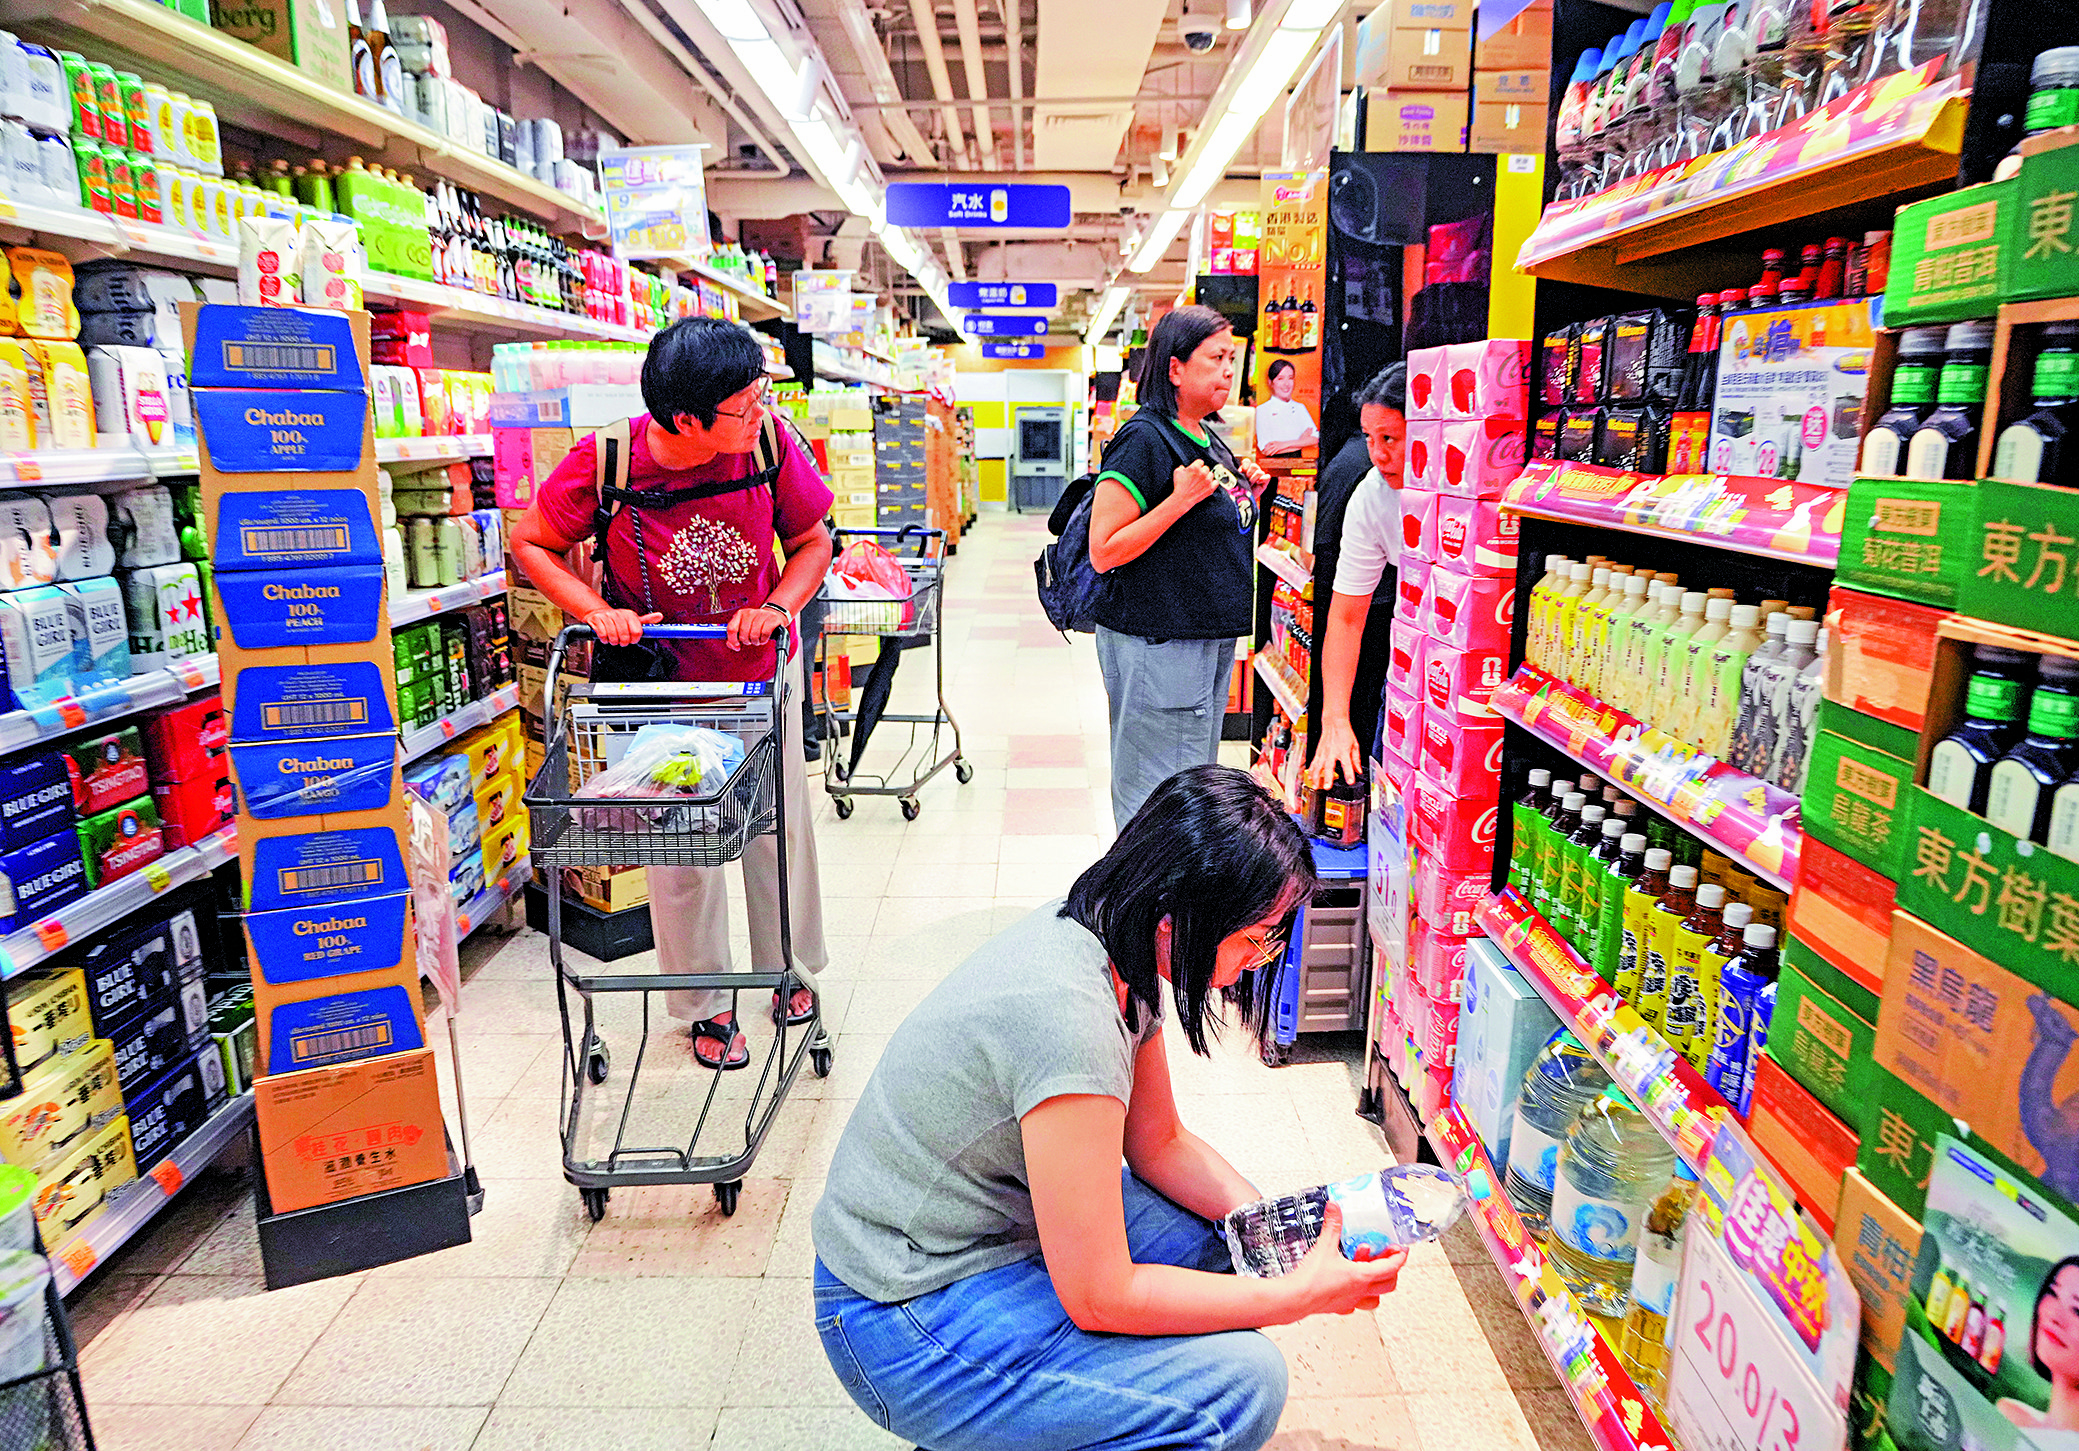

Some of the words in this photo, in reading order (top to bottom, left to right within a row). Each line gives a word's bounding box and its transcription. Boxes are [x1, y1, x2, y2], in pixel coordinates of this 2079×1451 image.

[952, 193, 984, 210] 汽水
[1266, 226, 1322, 264] No.1
[244, 407, 326, 426] Chabaa
[272, 445, 306, 455] APPLE
[1977, 518, 2075, 594] 東方
[262, 584, 341, 601] Chabaa
[90, 602, 120, 619] BLUE
[32, 613, 64, 632] BLUE
[92, 618, 123, 635] GIRL
[286, 617, 324, 627] PEACH
[36, 630, 69, 648] GIRL
[278, 756, 355, 774] Chabaa
[292, 916, 367, 936] Chabaa
[303, 950, 329, 962] RED
[330, 945, 363, 959] GRAPE
[96, 963, 134, 993] BLUE
[100, 978, 137, 1008] GIRL
[114, 1035, 148, 1067] BLUE
[117, 1051, 149, 1081] GIRL
[131, 1105, 166, 1138] BLUE
[135, 1119, 168, 1151] GIRL
